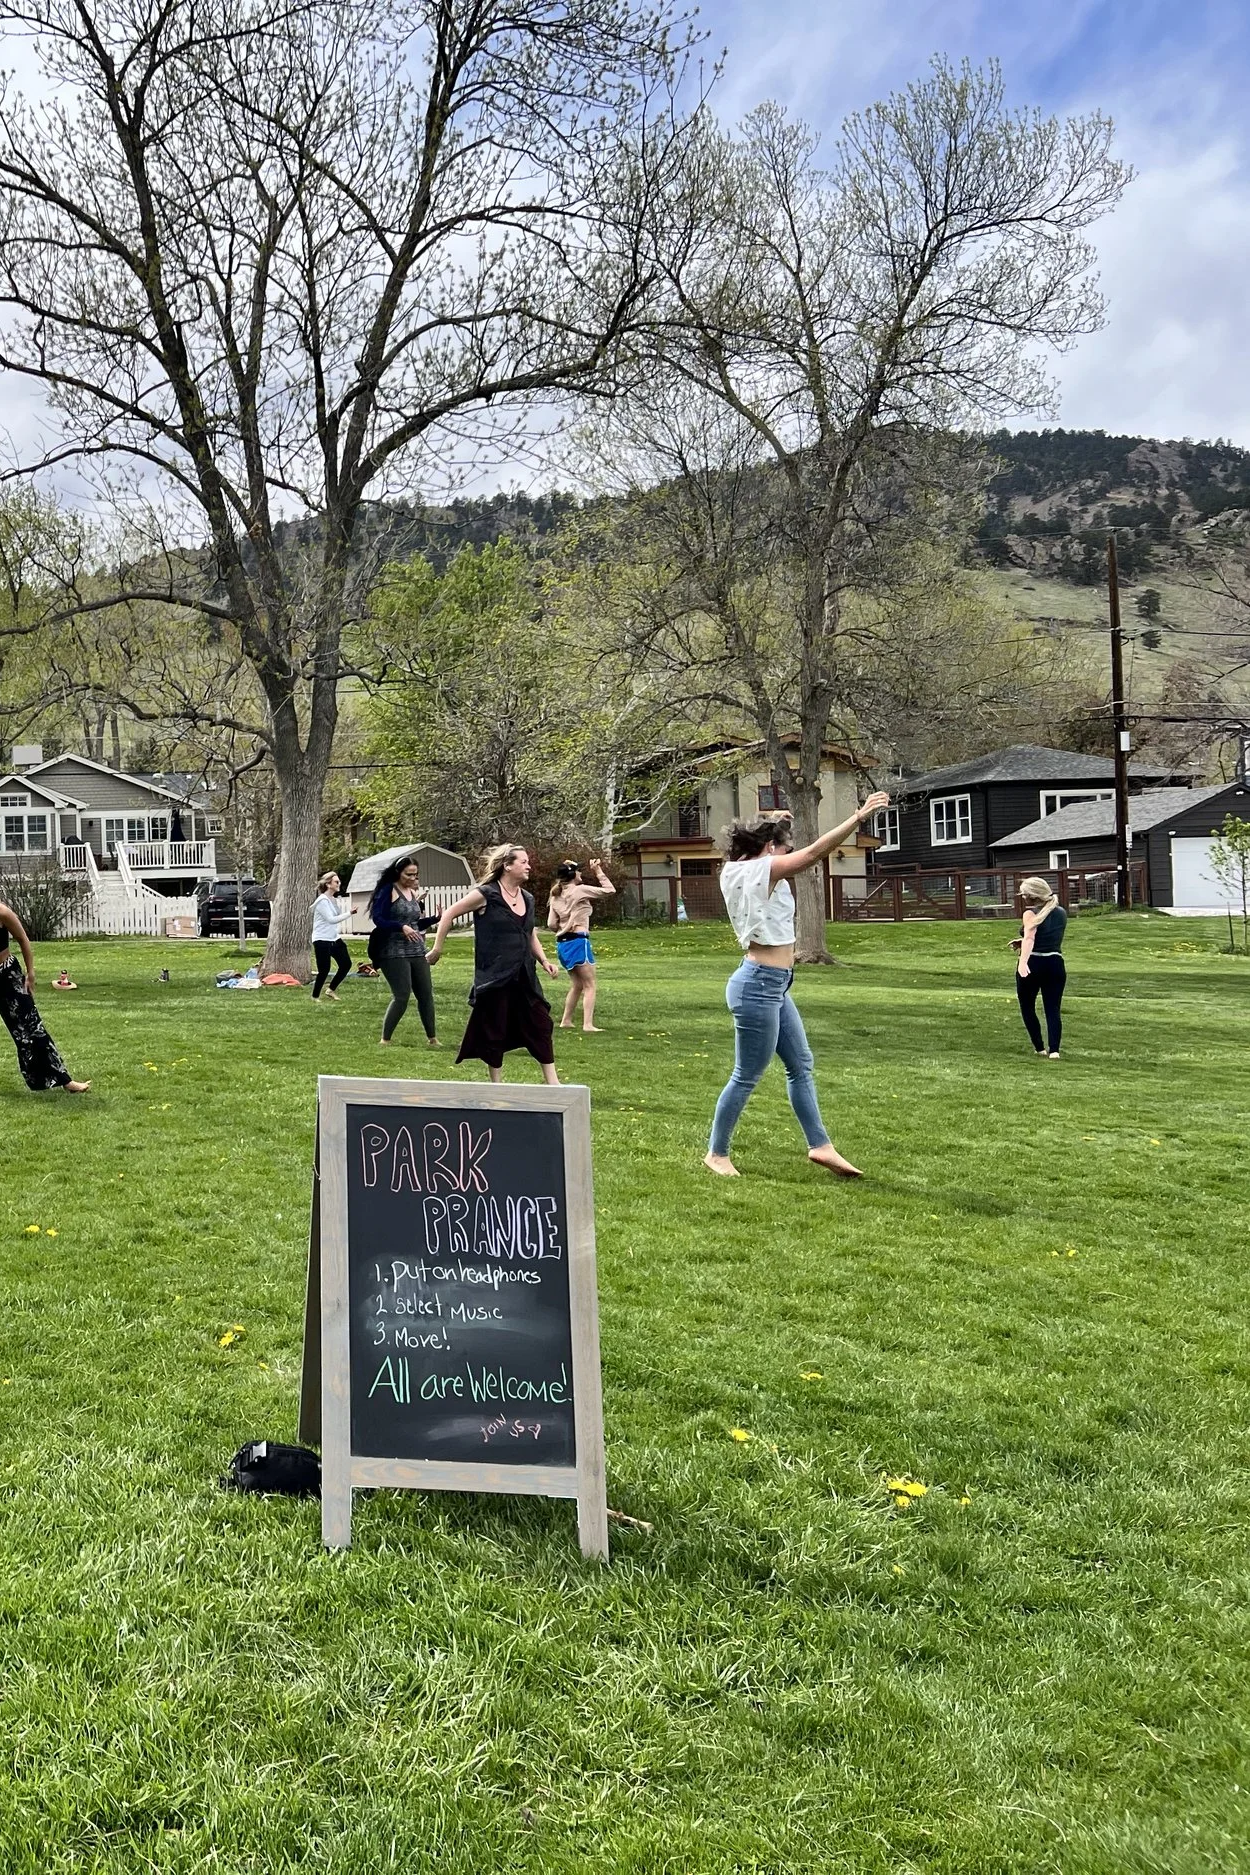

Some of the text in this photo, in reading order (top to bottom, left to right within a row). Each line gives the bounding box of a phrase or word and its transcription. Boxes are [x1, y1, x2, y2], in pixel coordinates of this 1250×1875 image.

[360, 1121, 492, 1193] PARK
[422, 1194, 562, 1260] PRANCE
[395, 1326, 451, 1350] Move!
[368, 1355, 411, 1404] All
[420, 1373, 464, 1400] are
